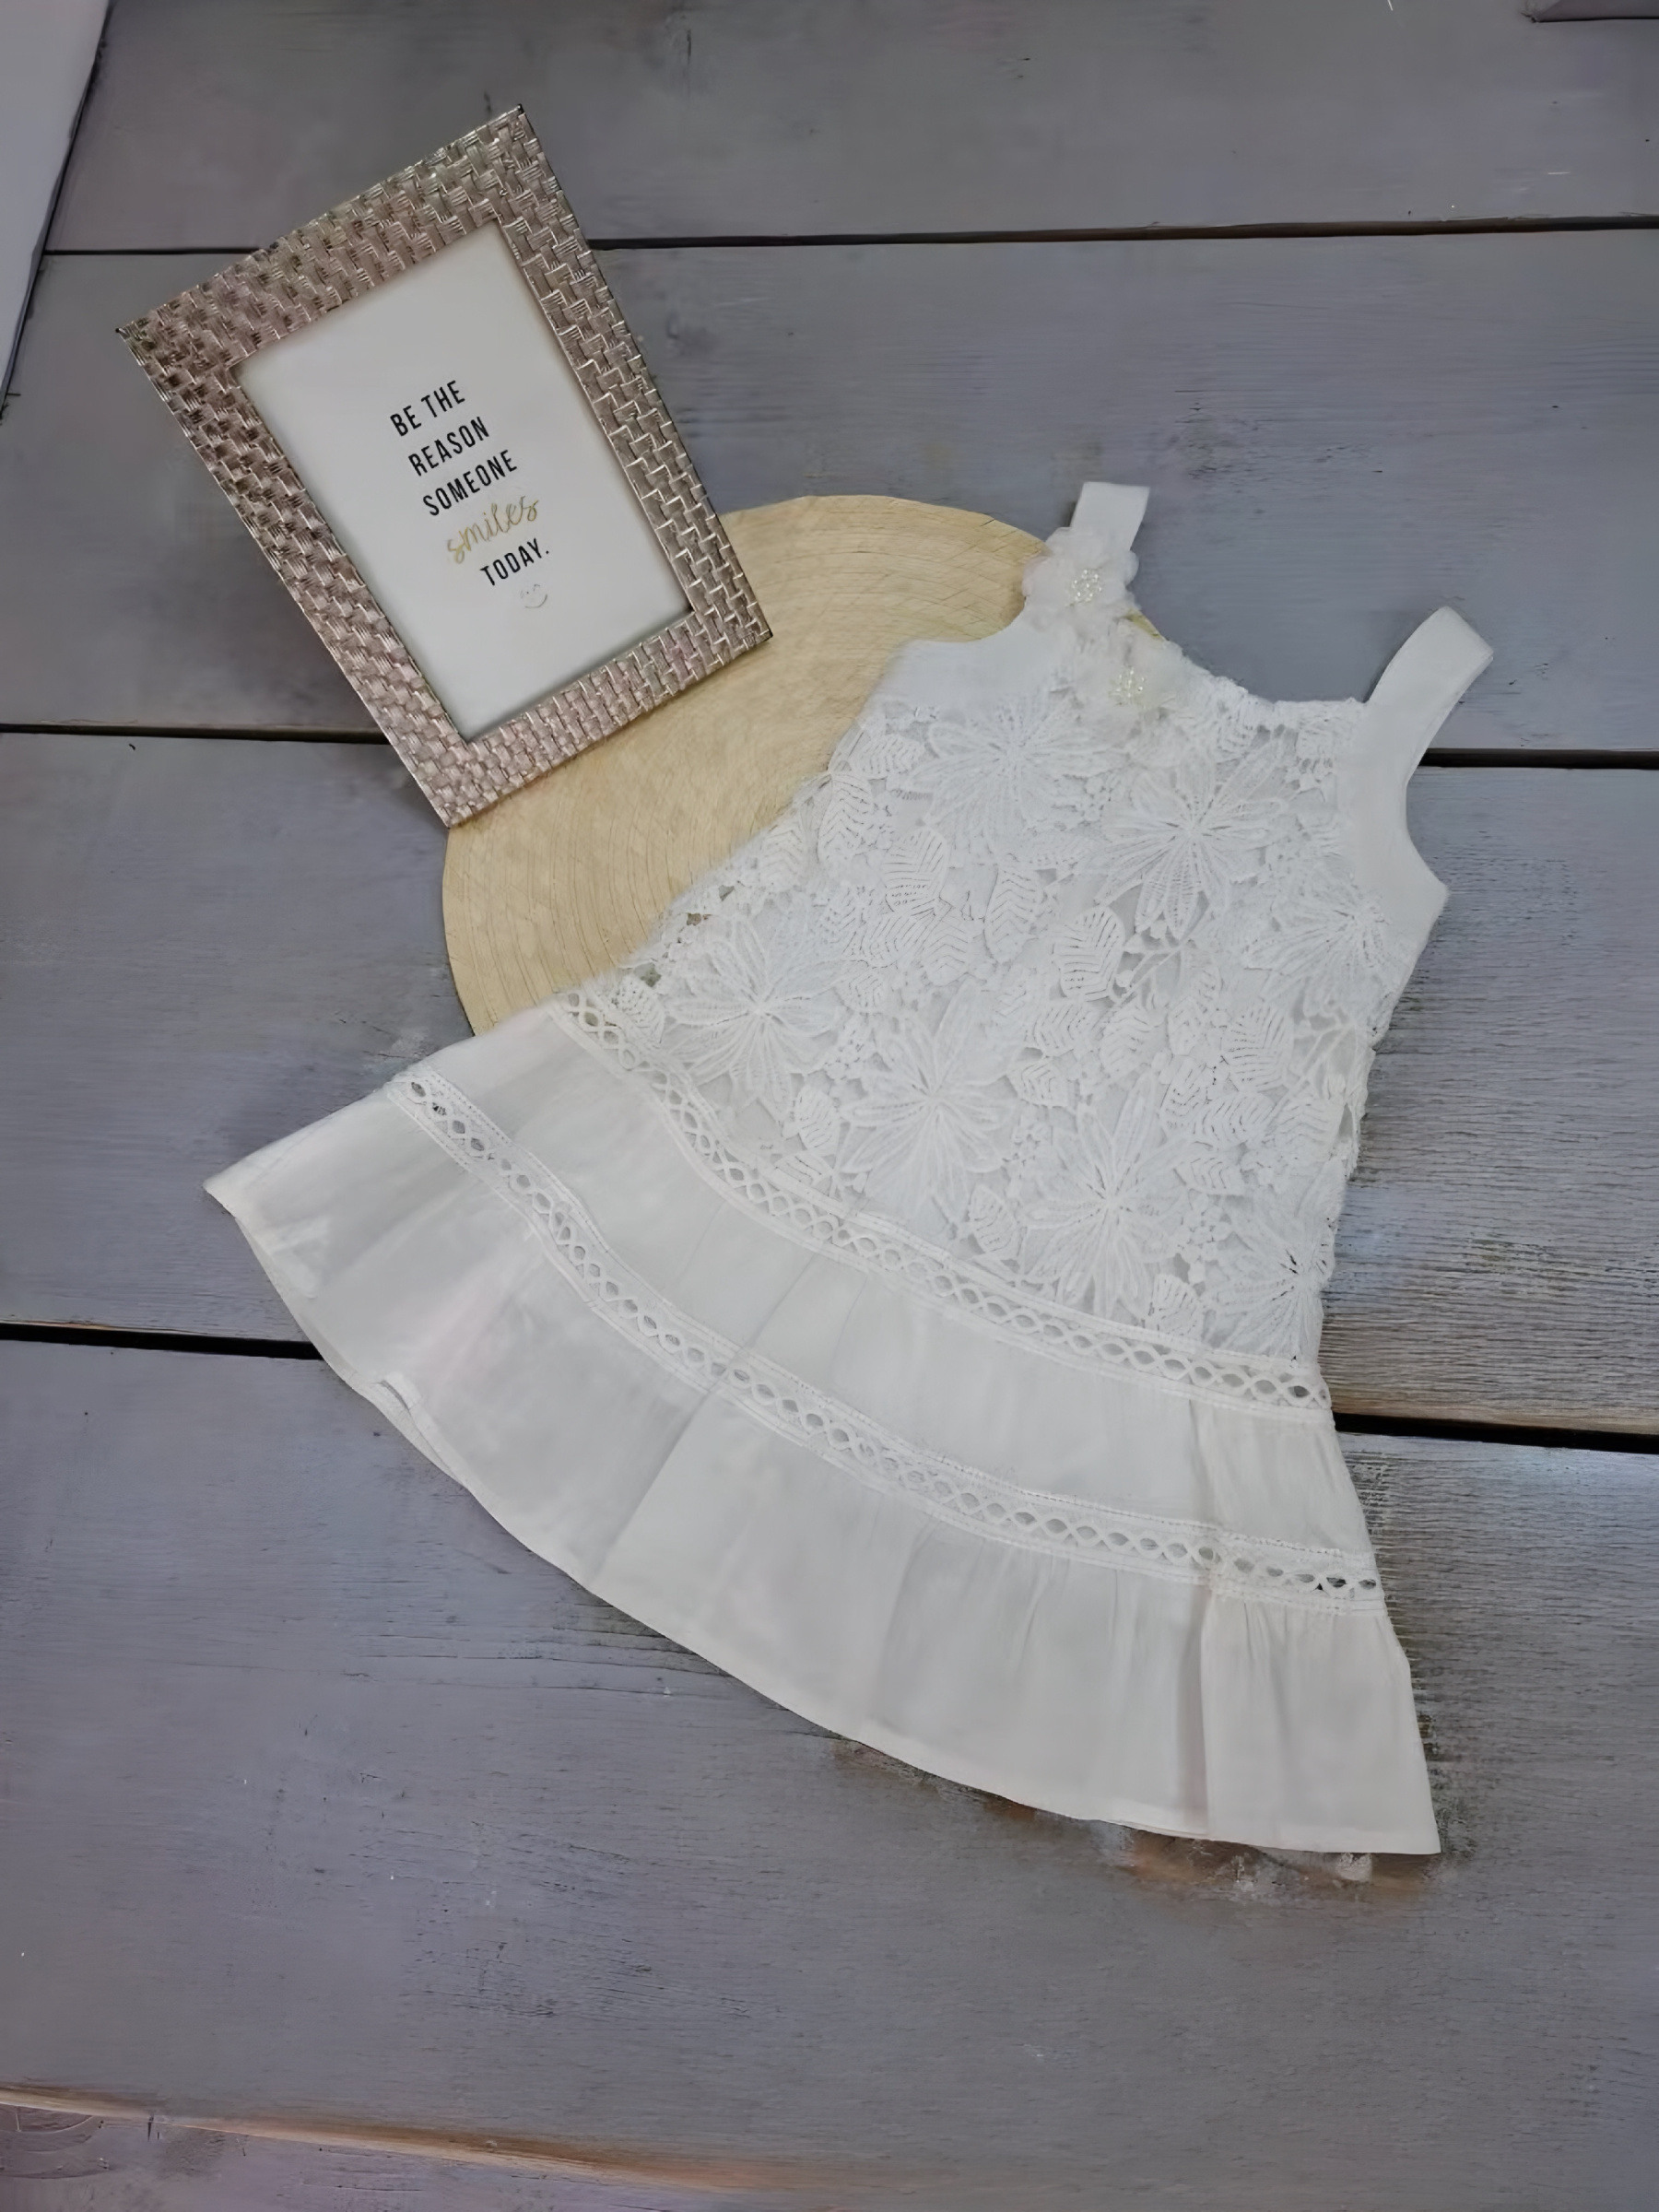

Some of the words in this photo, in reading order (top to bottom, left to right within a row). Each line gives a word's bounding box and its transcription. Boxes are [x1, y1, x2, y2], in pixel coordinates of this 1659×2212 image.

[390, 406, 422, 437] BE
[420, 380, 465, 418] THE
[407, 416, 490, 477] REASON
[422, 449, 518, 516] SOMEONE
[447, 495, 539, 564] smiles
[479, 537, 549, 586] TODAY.
